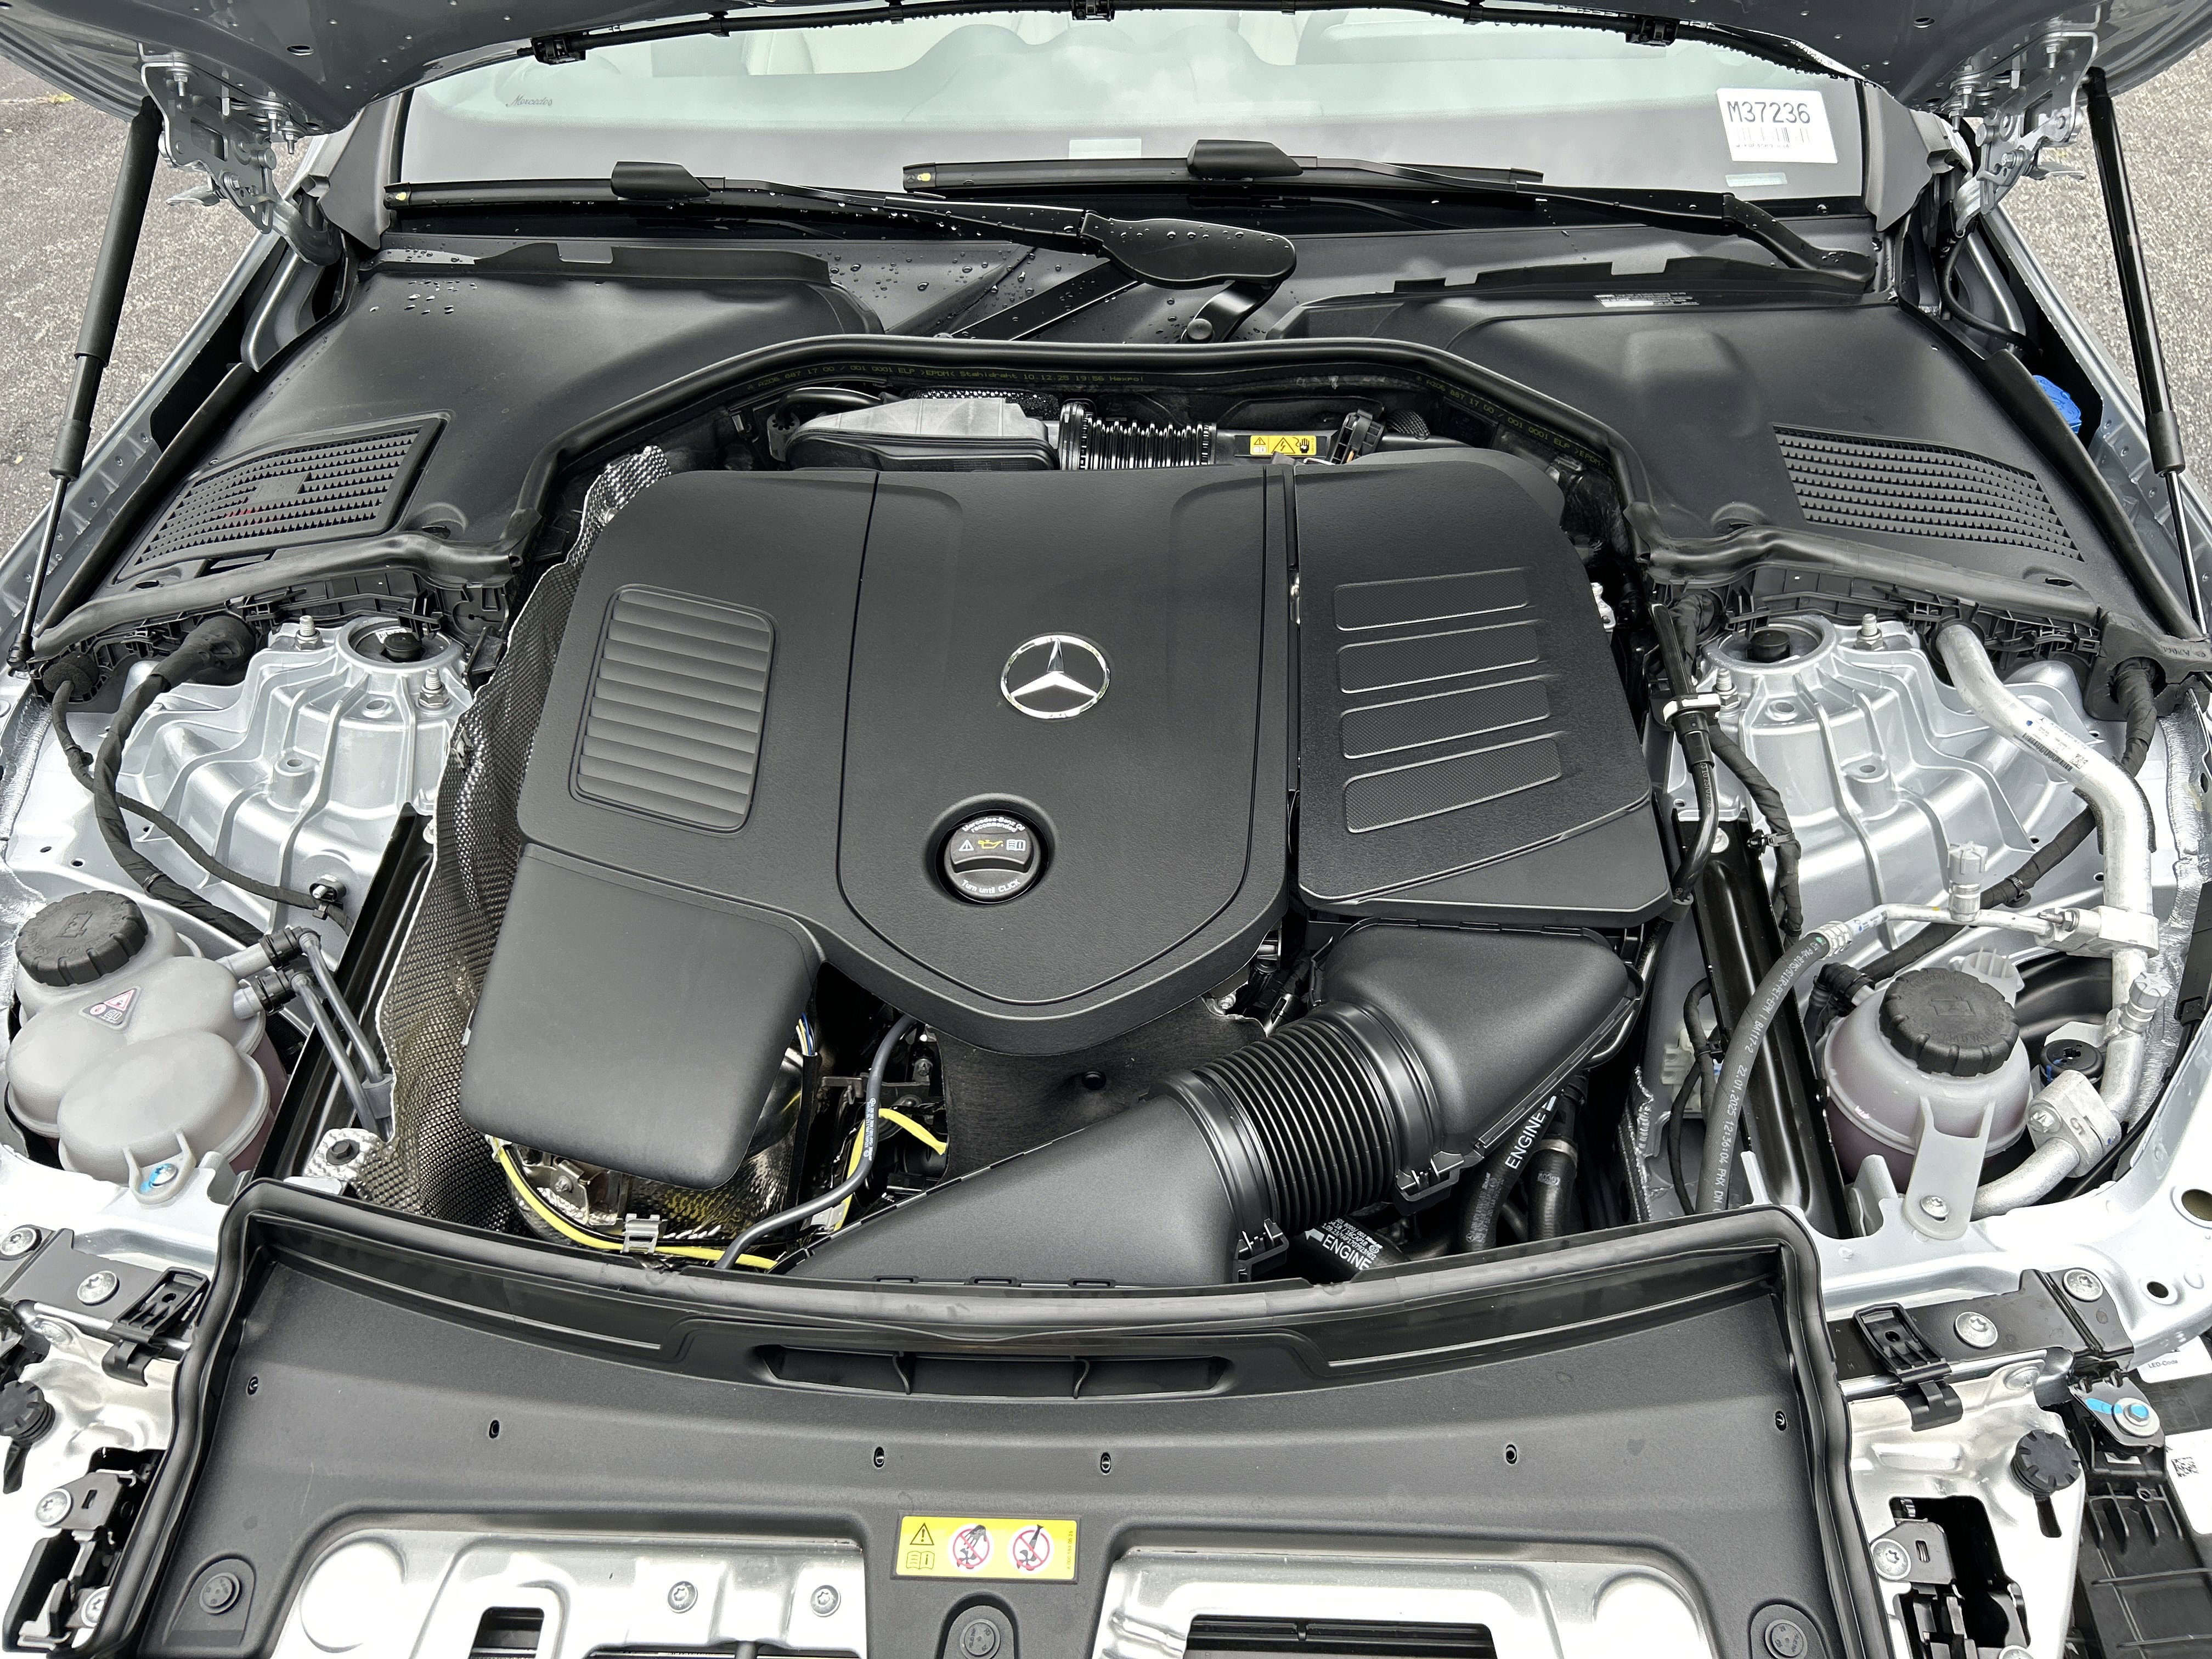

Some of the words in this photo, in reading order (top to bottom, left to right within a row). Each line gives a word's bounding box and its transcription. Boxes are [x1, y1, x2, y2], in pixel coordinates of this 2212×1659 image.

[506, 93, 553, 107] Mercedes
[1726, 101, 1810, 124] M37236
[1469, 397, 1480, 407] 17
[961, 816, 1017, 832] Mercedes-Benz
[970, 821, 1018, 833] recommended
[962, 879, 977, 893] Turn
[979, 886, 995, 894] until
[998, 878, 1021, 893] CLICK
[1727, 1064, 1747, 1118] 22.01.2025
[1504, 1112, 1547, 1169] ENGINE
[1719, 1120, 1735, 1164] 12:36:04
[1714, 1168, 1727, 1187] PHX
[1713, 1190, 1724, 1204] DN
[1322, 1234, 1372, 1271] ENGINE
